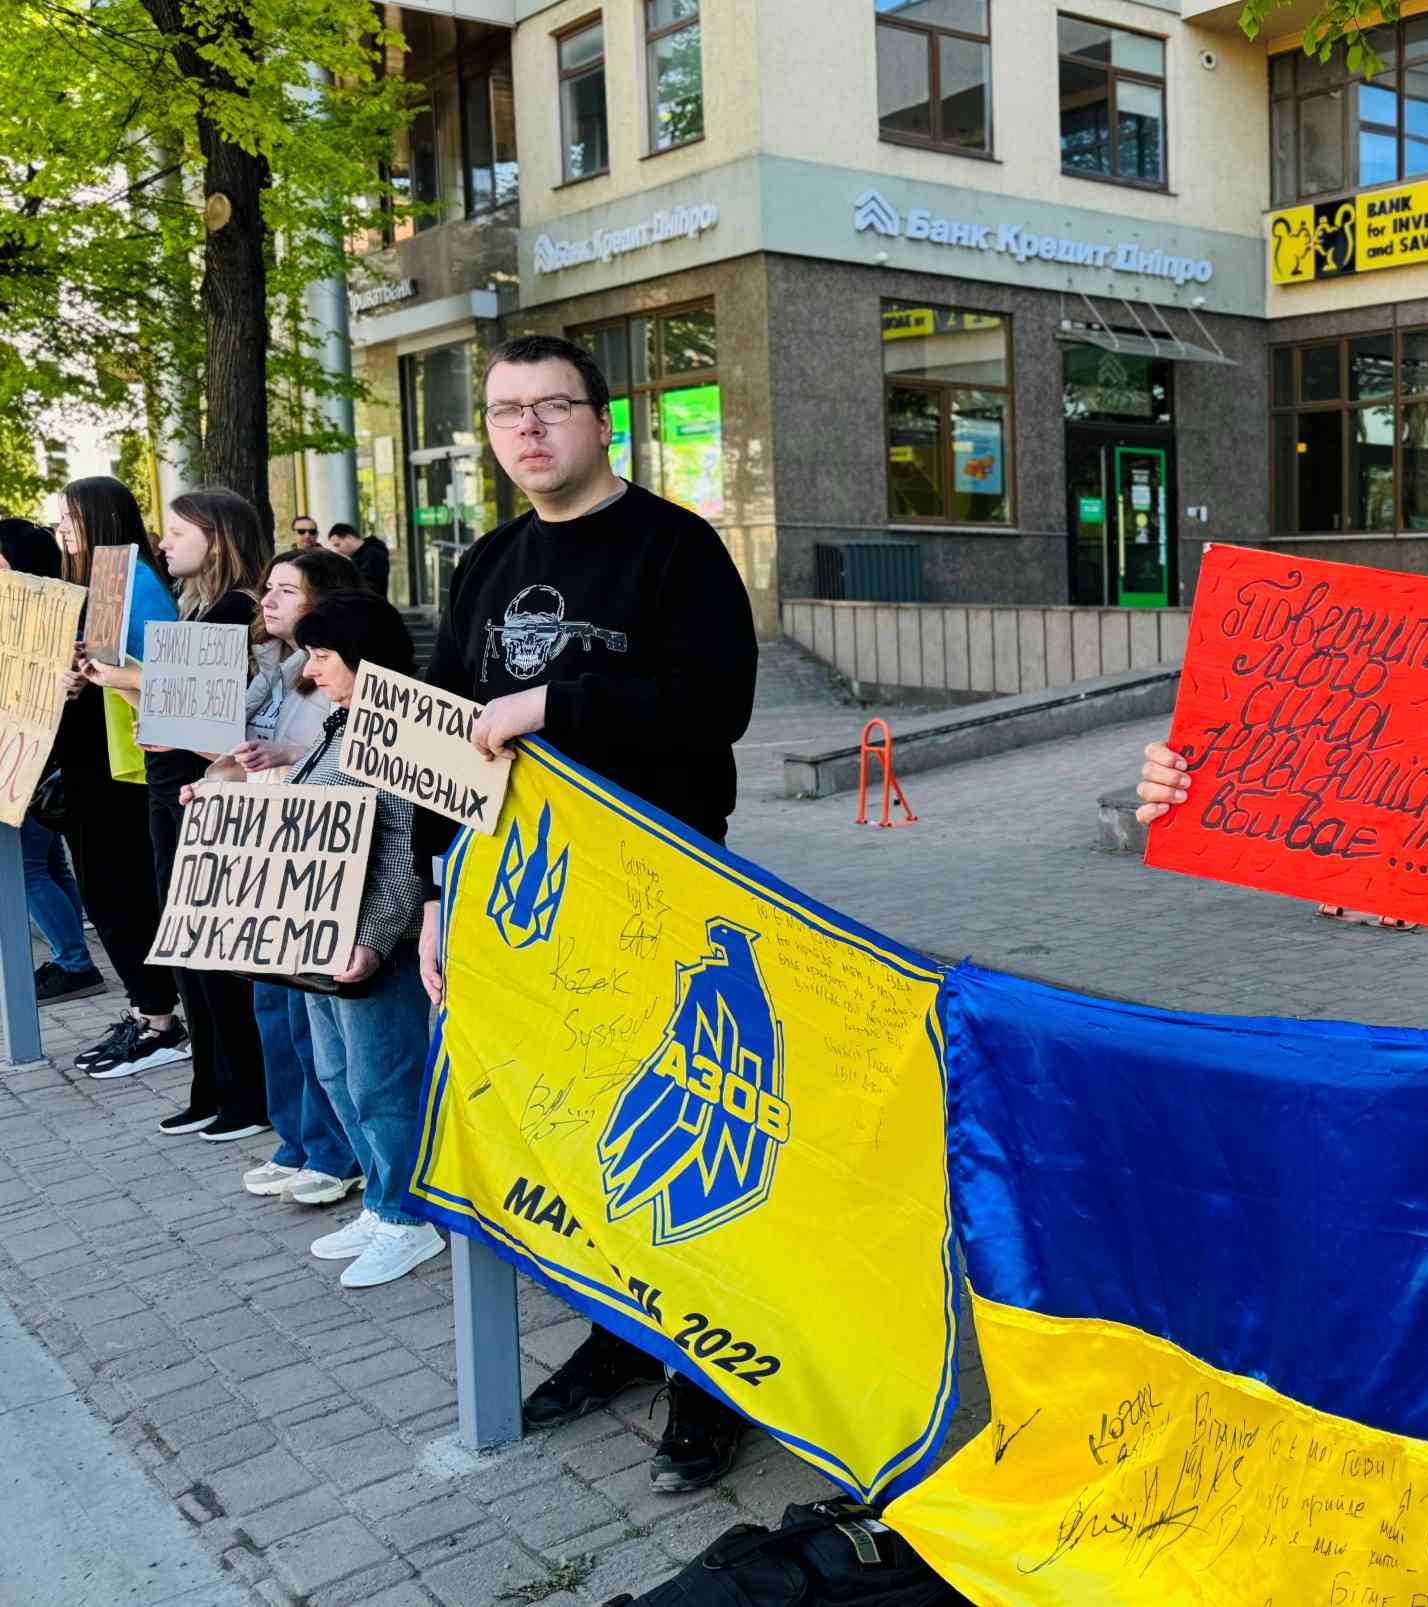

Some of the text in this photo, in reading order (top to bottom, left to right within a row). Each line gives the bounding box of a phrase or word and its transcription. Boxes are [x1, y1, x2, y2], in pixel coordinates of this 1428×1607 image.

[1367, 196, 1412, 218] BANK
[1367, 223, 1386, 239] for
[906, 207, 1214, 285] Банк Кредит Дніпро
[1367, 241, 1394, 258] and
[183, 794, 270, 848] ВОНИ
[173, 852, 346, 912] ПОКИ МИ
[154, 914, 340, 966] ШУКАЄМО
[653, 1040, 791, 1144] АЗОВ
[673, 1311, 782, 1387] 2022
